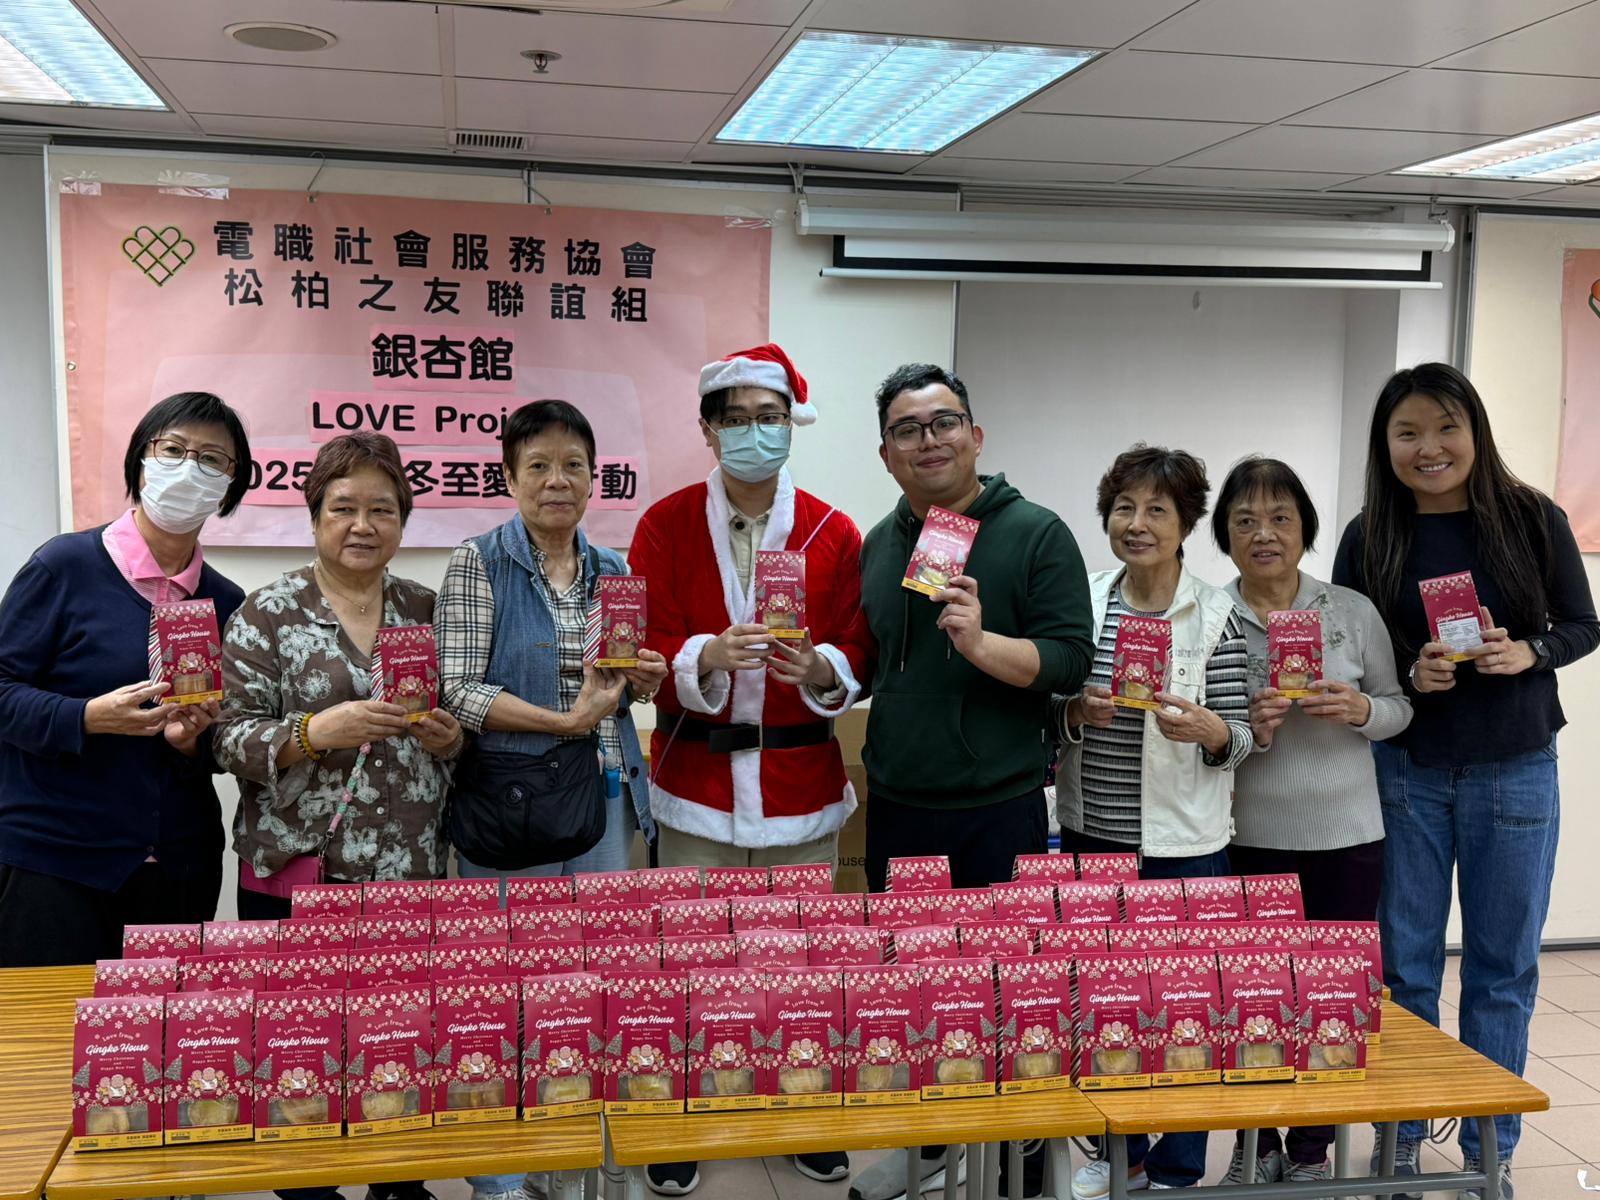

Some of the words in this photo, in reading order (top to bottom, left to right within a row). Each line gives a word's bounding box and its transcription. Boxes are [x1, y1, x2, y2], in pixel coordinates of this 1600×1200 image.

[214, 221, 656, 279] 電職社會服務協會
[224, 268, 647, 322] 松柏之友聯誼組
[372, 333, 513, 381] 銀杏館
[313, 402, 415, 431] LOVE
[1162, 991, 1187, 1001] Gingko
[1188, 990, 1211, 998] House
[1233, 988, 1259, 998] Gingko
[1260, 988, 1283, 996] House
[1307, 991, 1333, 1001] Gingko
[1334, 991, 1356, 999] House
[1012, 998, 1037, 1008] Gingko
[1038, 997, 1060, 1005] House
[1090, 994, 1116, 1004] Gingko
[1117, 994, 1140, 1002] House
[932, 1001, 959, 1011] Gingko
[960, 1000, 984, 1009] House
[701, 1012, 729, 1022] Gingko
[730, 1011, 756, 1019] House
[778, 1010, 806, 1020] Gingko
[807, 1010, 832, 1018] House
[856, 1008, 884, 1018] Gingko
[885, 1008, 910, 1016] House
[536, 1018, 565, 1029] Gingko
[566, 1016, 592, 1025] House
[618, 1016, 648, 1026] Gingko
[649, 1015, 674, 1024] House
[448, 1023, 478, 1034] Gingko
[479, 1022, 506, 1030] House
[178, 1037, 210, 1049] Gingko
[211, 1036, 240, 1045] House
[268, 1037, 300, 1048] Gingko
[301, 1036, 329, 1045] House
[359, 1032, 391, 1044] Gingko
[392, 1030, 419, 1039] House
[86, 1044, 119, 1055] Gingko
[120, 1043, 149, 1052] House
